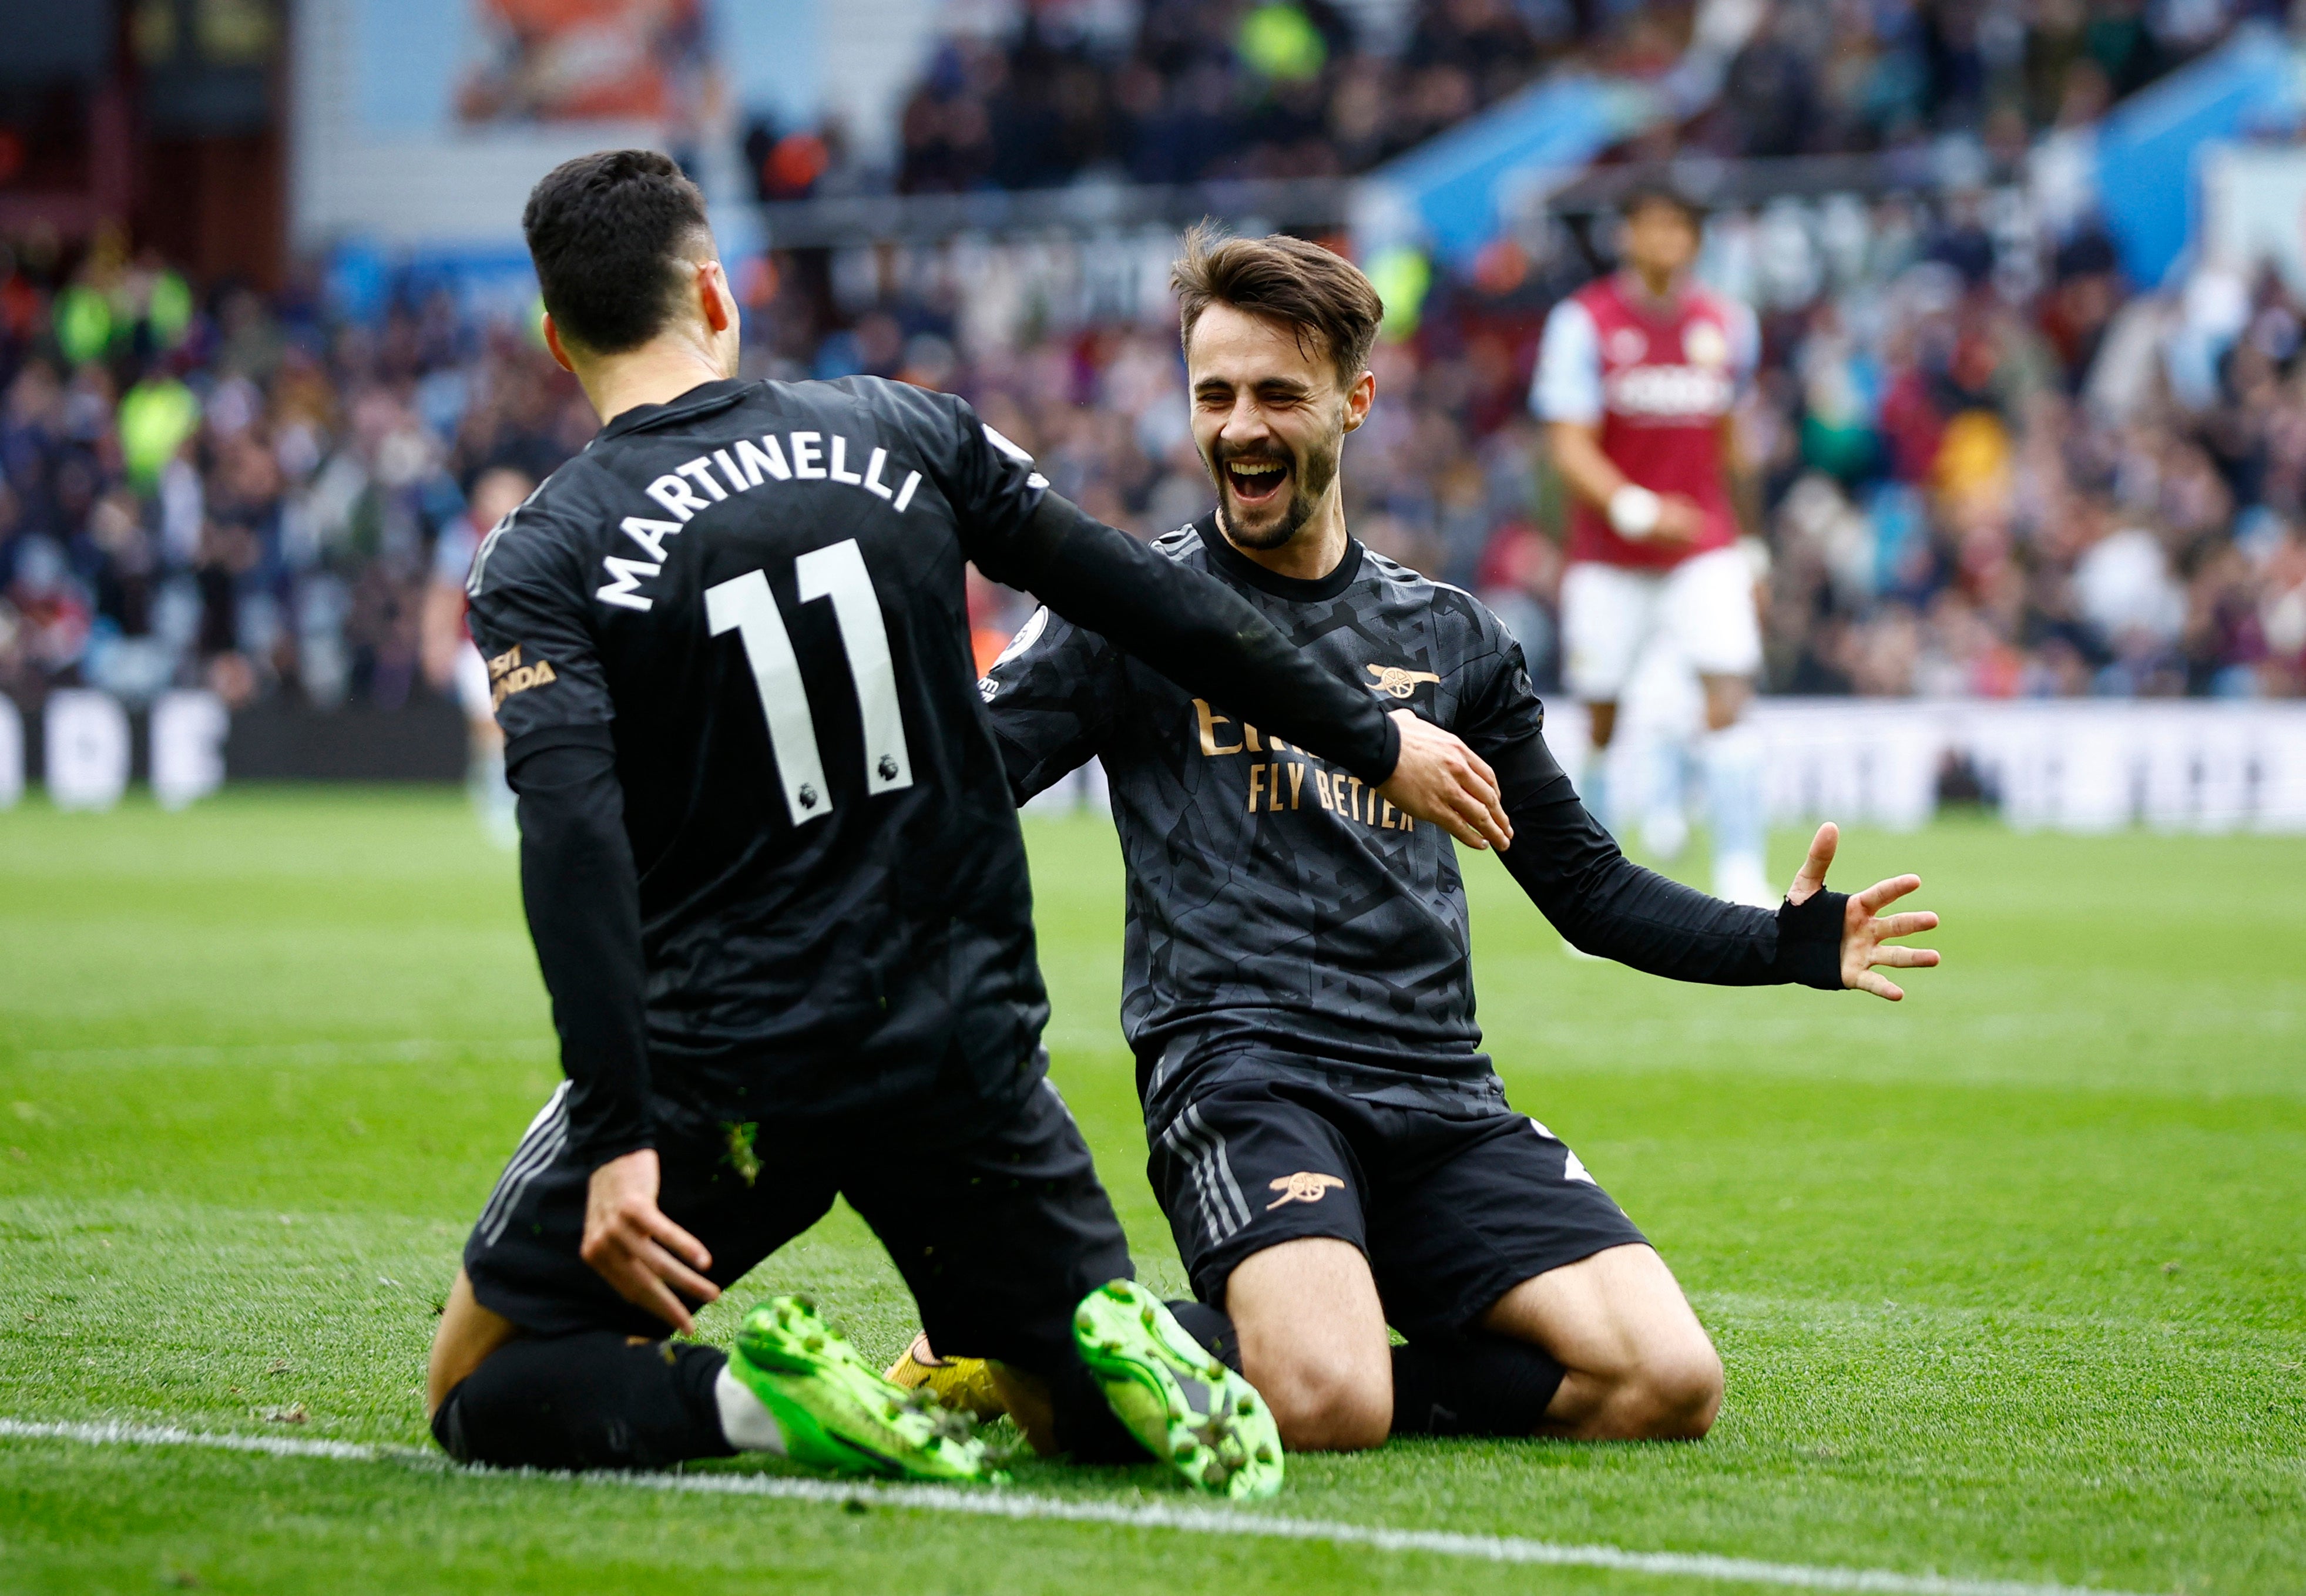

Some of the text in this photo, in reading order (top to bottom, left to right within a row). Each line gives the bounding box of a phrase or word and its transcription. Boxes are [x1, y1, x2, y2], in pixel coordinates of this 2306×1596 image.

[596, 431, 922, 611] MARTINELLI
[487, 644, 522, 679] SIT
[492, 659, 557, 712] NDA
[704, 537, 913, 826] 11
[1248, 762, 1305, 812] FLY
